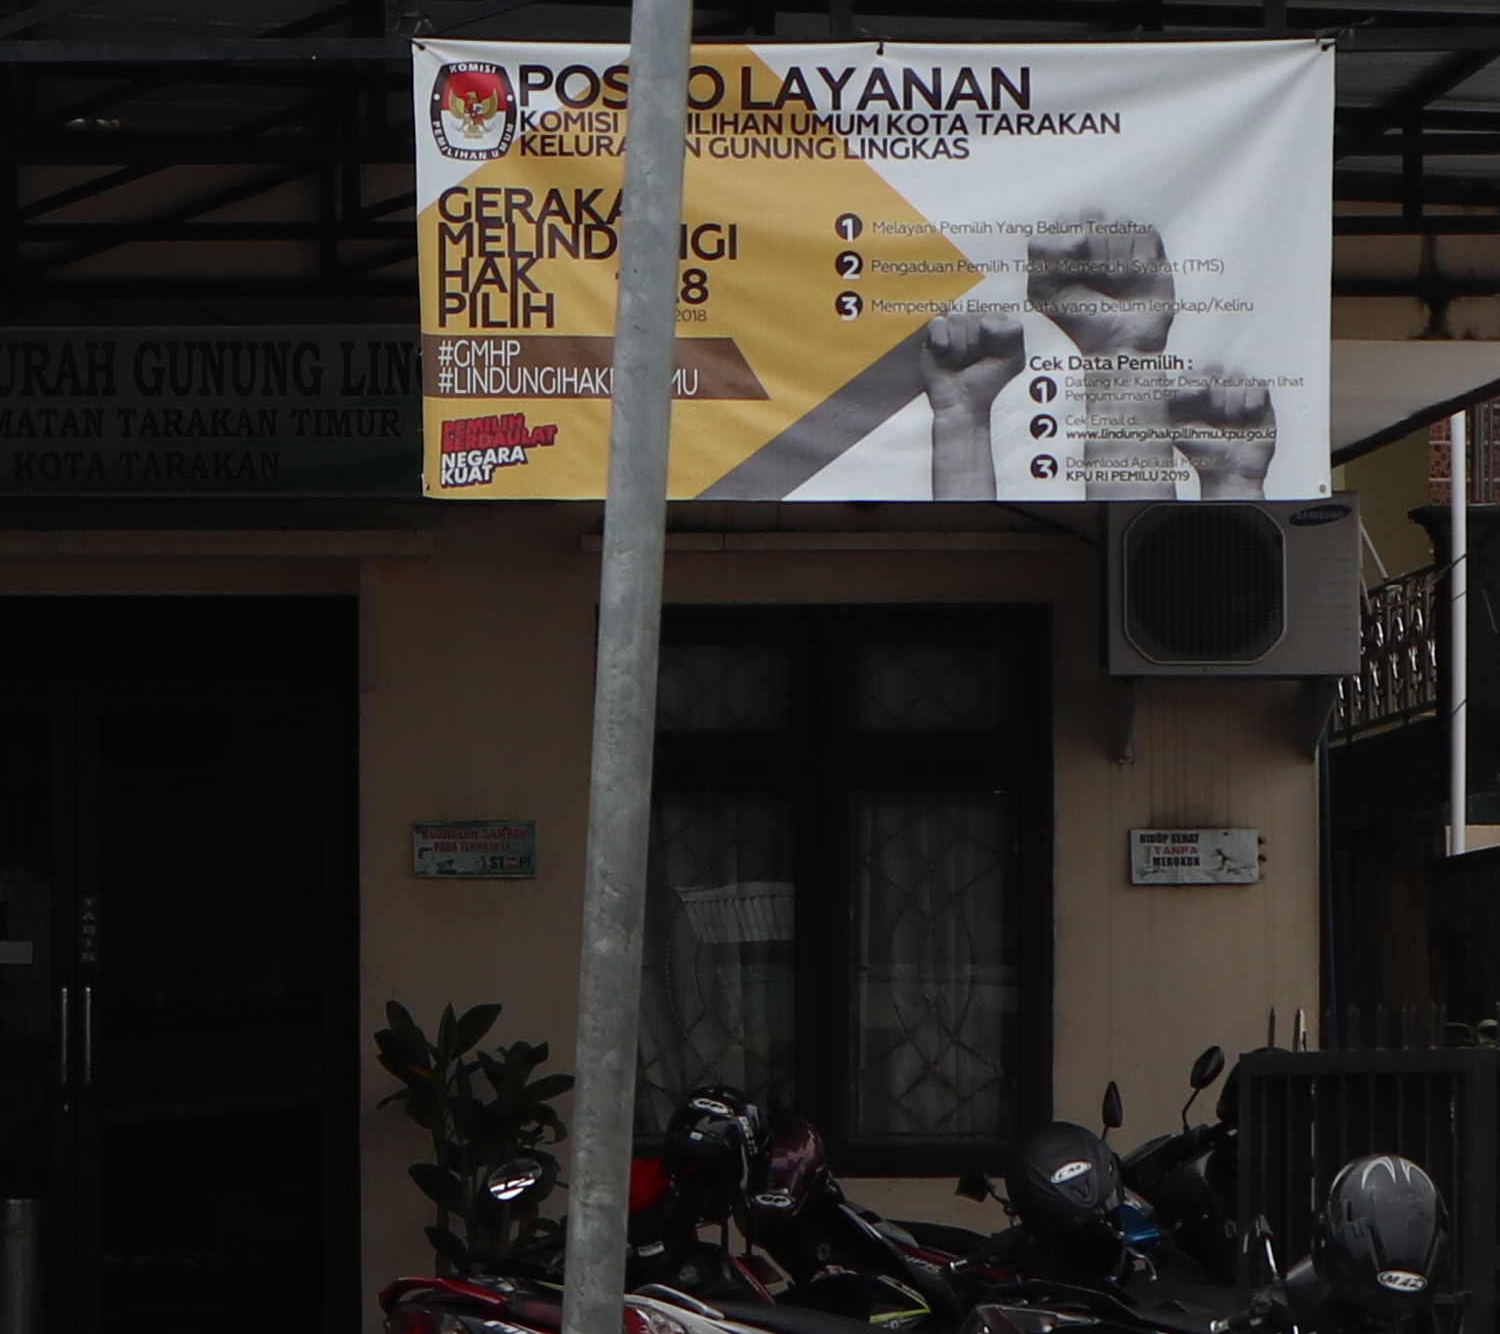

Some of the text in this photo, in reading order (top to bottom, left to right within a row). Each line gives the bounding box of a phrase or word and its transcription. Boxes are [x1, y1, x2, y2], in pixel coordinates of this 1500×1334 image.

[519, 64, 1031, 111] POSO LAYANAN
[521, 110, 1120, 136] KOMISI UMUM KOTA TARAKAN
[709, 136, 969, 160] GUNUNG LINGKAS
[873, 221, 936, 235] Melayani
[940, 221, 992, 234] Pemilih
[996, 221, 1033, 237] Yang
[1037, 221, 1083, 234] Belum
[438, 223, 737, 260] MELINDGI
[438, 256, 541, 293] HAK
[438, 292, 554, 328] PILIH
[871, 299, 1253, 315] Memperbaiki Elemen belum lengkap/Keliru
[438, 340, 520, 367] #GMHP
[1030, 354, 1183, 371] Cek Data Pemilih
[132, 341, 324, 398] GUNUNG
[115, 407, 278, 439] TARAKAN
[289, 407, 402, 439] TIMUR
[442, 413, 525, 436] PEMILIH
[13, 450, 280, 481] KOTA TARAKAN
[441, 445, 525, 469] NEGARA
[441, 465, 494, 486] KUAT
[1066, 471, 1190, 481] KPU RI PEMILU 2019
[1140, 834, 1199, 843] HIDUP SEHAT
[1153, 846, 1198, 855] TANPA
[1153, 857, 1199, 866] MEROKOK
[81, 898, 97, 961] TARIK
